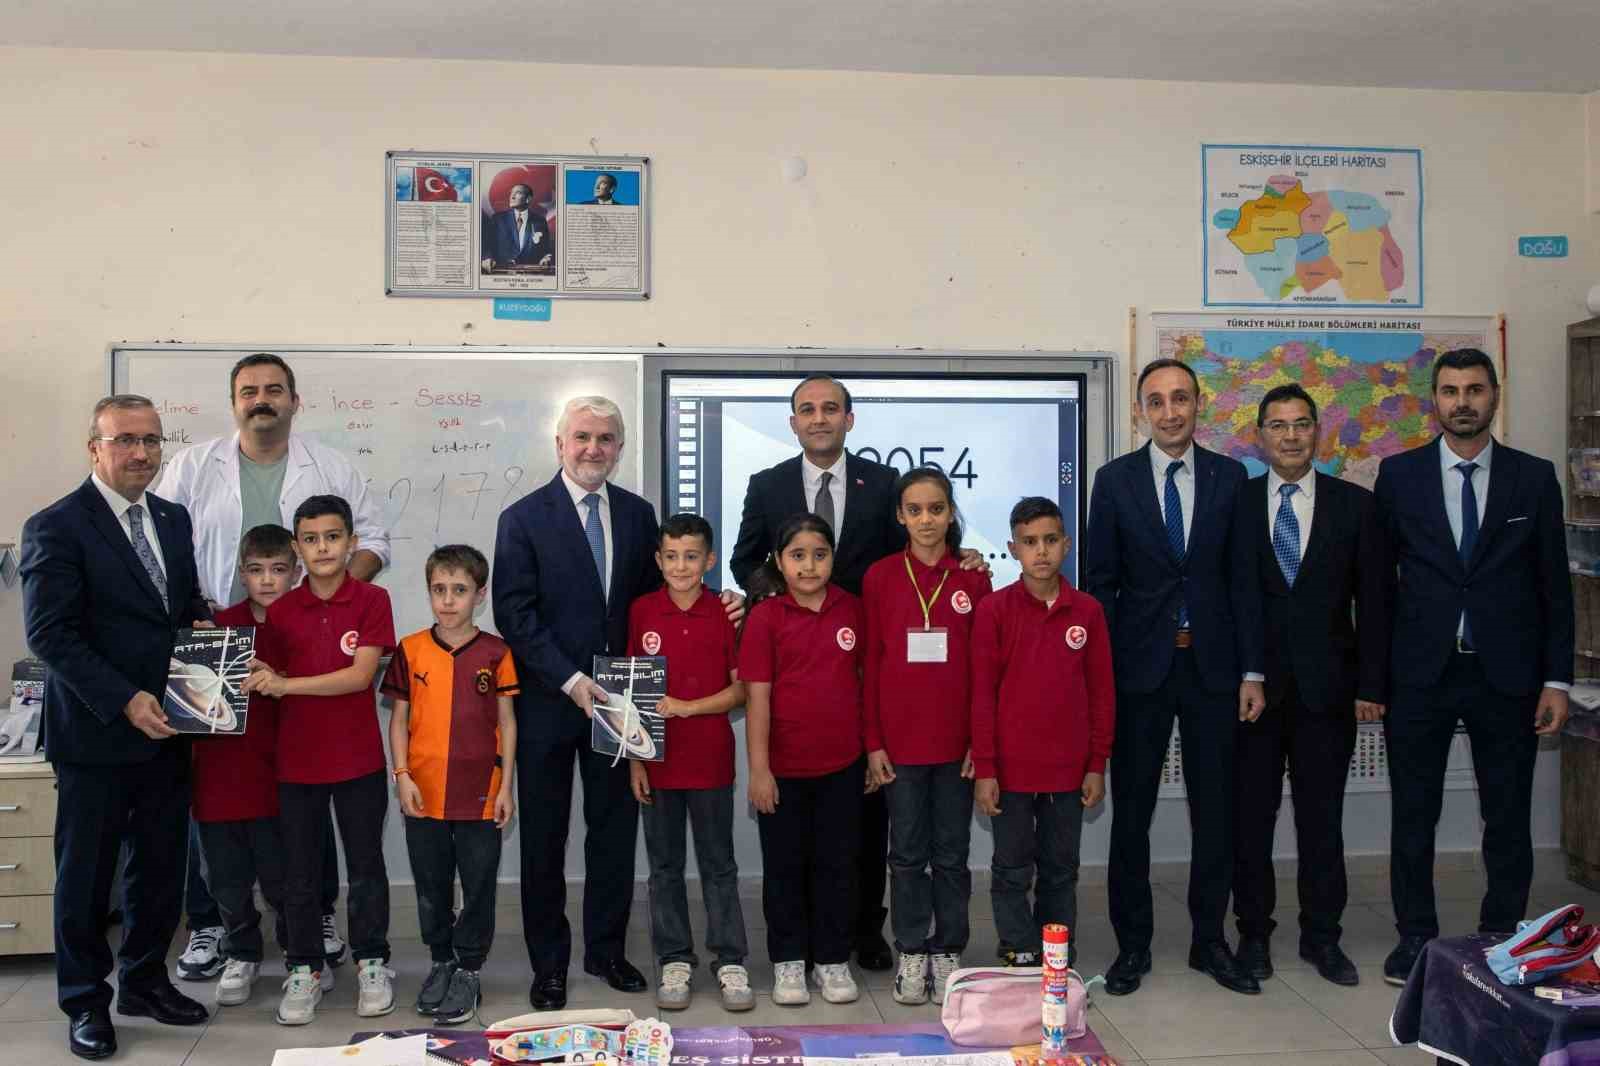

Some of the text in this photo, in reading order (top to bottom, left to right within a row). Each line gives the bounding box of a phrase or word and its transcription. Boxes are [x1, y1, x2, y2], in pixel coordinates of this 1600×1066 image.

[1239, 152, 1386, 169] ESKİŞEHİR İLÇELERİ HARİTASI
[1523, 239, 1562, 256] DOĞU
[1226, 318, 1421, 330] TÜRKİYE MÜLKİ İDARE BÖLÜMLERİ HARİTASI
[720, 1054, 803, 1065] SİST
